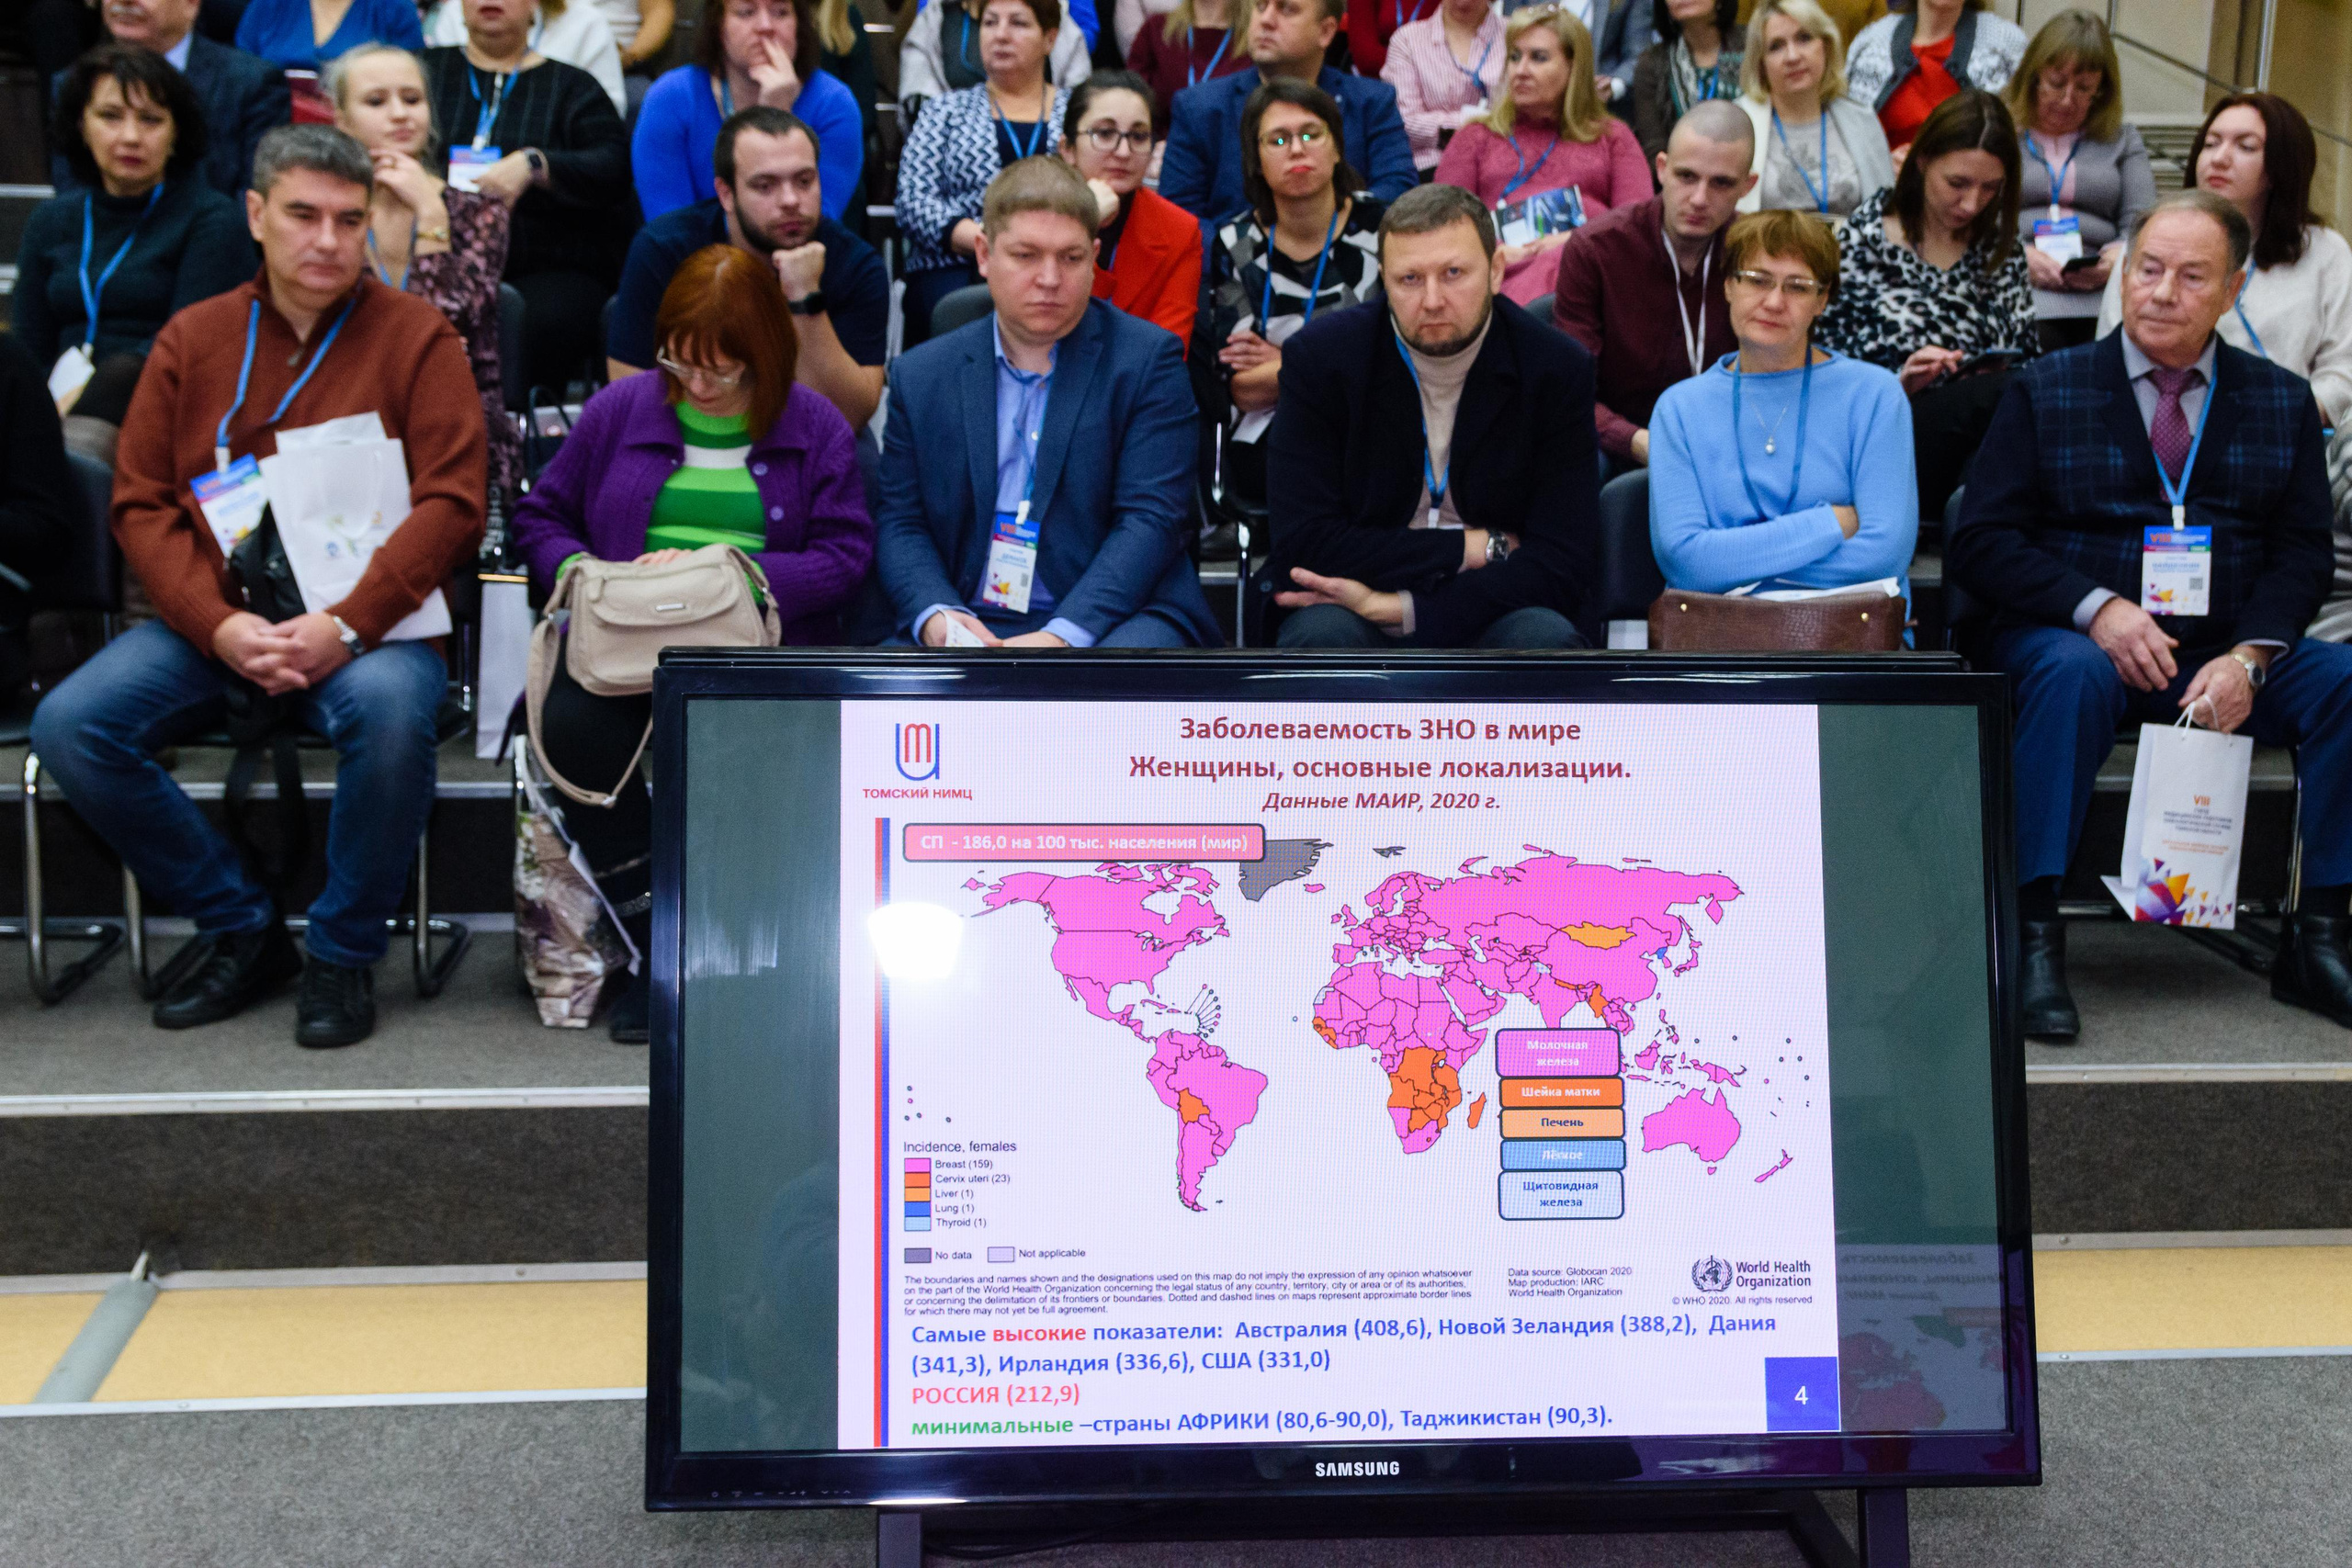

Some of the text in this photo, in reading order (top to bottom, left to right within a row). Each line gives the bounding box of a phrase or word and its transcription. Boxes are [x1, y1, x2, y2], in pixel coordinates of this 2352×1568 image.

[1180, 716, 1580, 746] Заболеваемость ЗНО в мире
[1129, 755, 1631, 784] Женщины, основные локализации.
[862, 786, 972, 800] ТОМСКИЙ НИМЦ
[1261, 792, 1499, 812] Данные МАИР, 2020 г.
[920, 834, 1247, 852] СП 186,0 на 100 тыс. населения (мир)
[1521, 1086, 1600, 1097] Шейка матки
[1541, 1117, 1584, 1126] Печень
[968, 1140, 1017, 1152] females
[935, 1158, 993, 1169] Breast (159)
[935, 1173, 1011, 1184] Cervix uteri (23)
[1522, 1181, 1599, 1192] Щитовидная
[934, 1189, 974, 1199] Liver (1)
[934, 1203, 975, 1214] Lung (1)
[1539, 1199, 1582, 1207] железа
[935, 1217, 987, 1228] Thyroid (1)
[935, 1251, 972, 1259] No data
[1019, 1248, 1086, 1258] Not applicable
[1508, 1267, 1530, 1277] Data
[1566, 1267, 1608, 1276] Globocan
[1610, 1266, 1632, 1275] 2020
[1736, 1259, 1811, 1273] World Health
[904, 1275, 922, 1284] The
[924, 1275, 974, 1284] boundaries
[977, 1275, 994, 1283] and
[1030, 1274, 1058, 1282] shown
[1061, 1274, 1079, 1282] and
[1080, 1273, 1095, 1281] the
[1097, 1273, 1154, 1283] designations
[1156, 1272, 1179, 1280] used
[1194, 1272, 1210, 1280] this
[1213, 1273, 1232, 1281] map
[1234, 1271, 1246, 1280] do
[1248, 1271, 1262, 1280] not
[1291, 1271, 1305, 1280] the
[1307, 1271, 1355, 1280] expression
[1357, 1269, 1366, 1279] of
[1368, 1271, 1385, 1280] any
[1386, 1270, 1419, 1279] opinion
[1421, 1269, 1472, 1278] whatsoever
[1508, 1278, 1528, 1288] Map
[1580, 1276, 1603, 1286] IARC
[1736, 1274, 1812, 1291] Organization
[935, 1286, 953, 1295] part
[955, 1285, 964, 1294] of
[966, 1285, 980, 1293] the
[983, 1284, 1010, 1293] World
[1012, 1285, 1042, 1293] Health
[1044, 1284, 1101, 1294] Organization
[1103, 1284, 1153, 1293] concerning
[1171, 1282, 1193, 1293] legal
[1195, 1282, 1222, 1291] status
[1224, 1280, 1234, 1291] of
[1235, 1283, 1252, 1292] any
[1331, 1281, 1346, 1291] city
[1508, 1287, 1623, 1298] World Health Organization
[916, 1297, 965, 1306] concerning
[967, 1296, 982, 1304] the
[984, 1296, 1035, 1304] delimitation
[1038, 1294, 1047, 1303] of
[1062, 1294, 1099, 1303] frontiers
[1168, 1292, 1197, 1302] Dotted
[1200, 1292, 1217, 1302] and
[1219, 1292, 1252, 1301] dashed
[1254, 1292, 1275, 1301] lines
[1292, 1292, 1317, 1301] maps
[1318, 1292, 1361, 1301] represent
[1363, 1291, 1418, 1301] approximate
[1419, 1290, 1448, 1298] border
[1451, 1290, 1472, 1298] lines
[1681, 1295, 1706, 1305] WHO
[1735, 1295, 1746, 1303] All
[1748, 1296, 1772, 1306] rights
[1775, 1295, 1813, 1303] reserved
[919, 1307, 944, 1315] which
[947, 1307, 970, 1315] there
[972, 1307, 992, 1316] may
[994, 1306, 1009, 1314] not
[1012, 1306, 1025, 1315] yet
[911, 1314, 1775, 1343] Самые высокие показатели: Австралия (408,6), Новой Зеландия (388,2), Дания
[911, 1348, 1330, 1378] (341,3), Ирландия (336,6), США (331,0)
[912, 1382, 1080, 1406] РОССИЯ (212,9)
[1794, 1385, 1808, 1404] 4
[911, 1419, 1073, 1435] минимальные
[1177, 1412, 1268, 1430] АФРИКИ
[1276, 1410, 1393, 1432] (80,6-90,0),
[1400, 1409, 1541, 1430] Таджикистан
[1547, 1405, 1612, 1428] (90,3).
[1316, 1461, 1399, 1476] SAMSUNG
